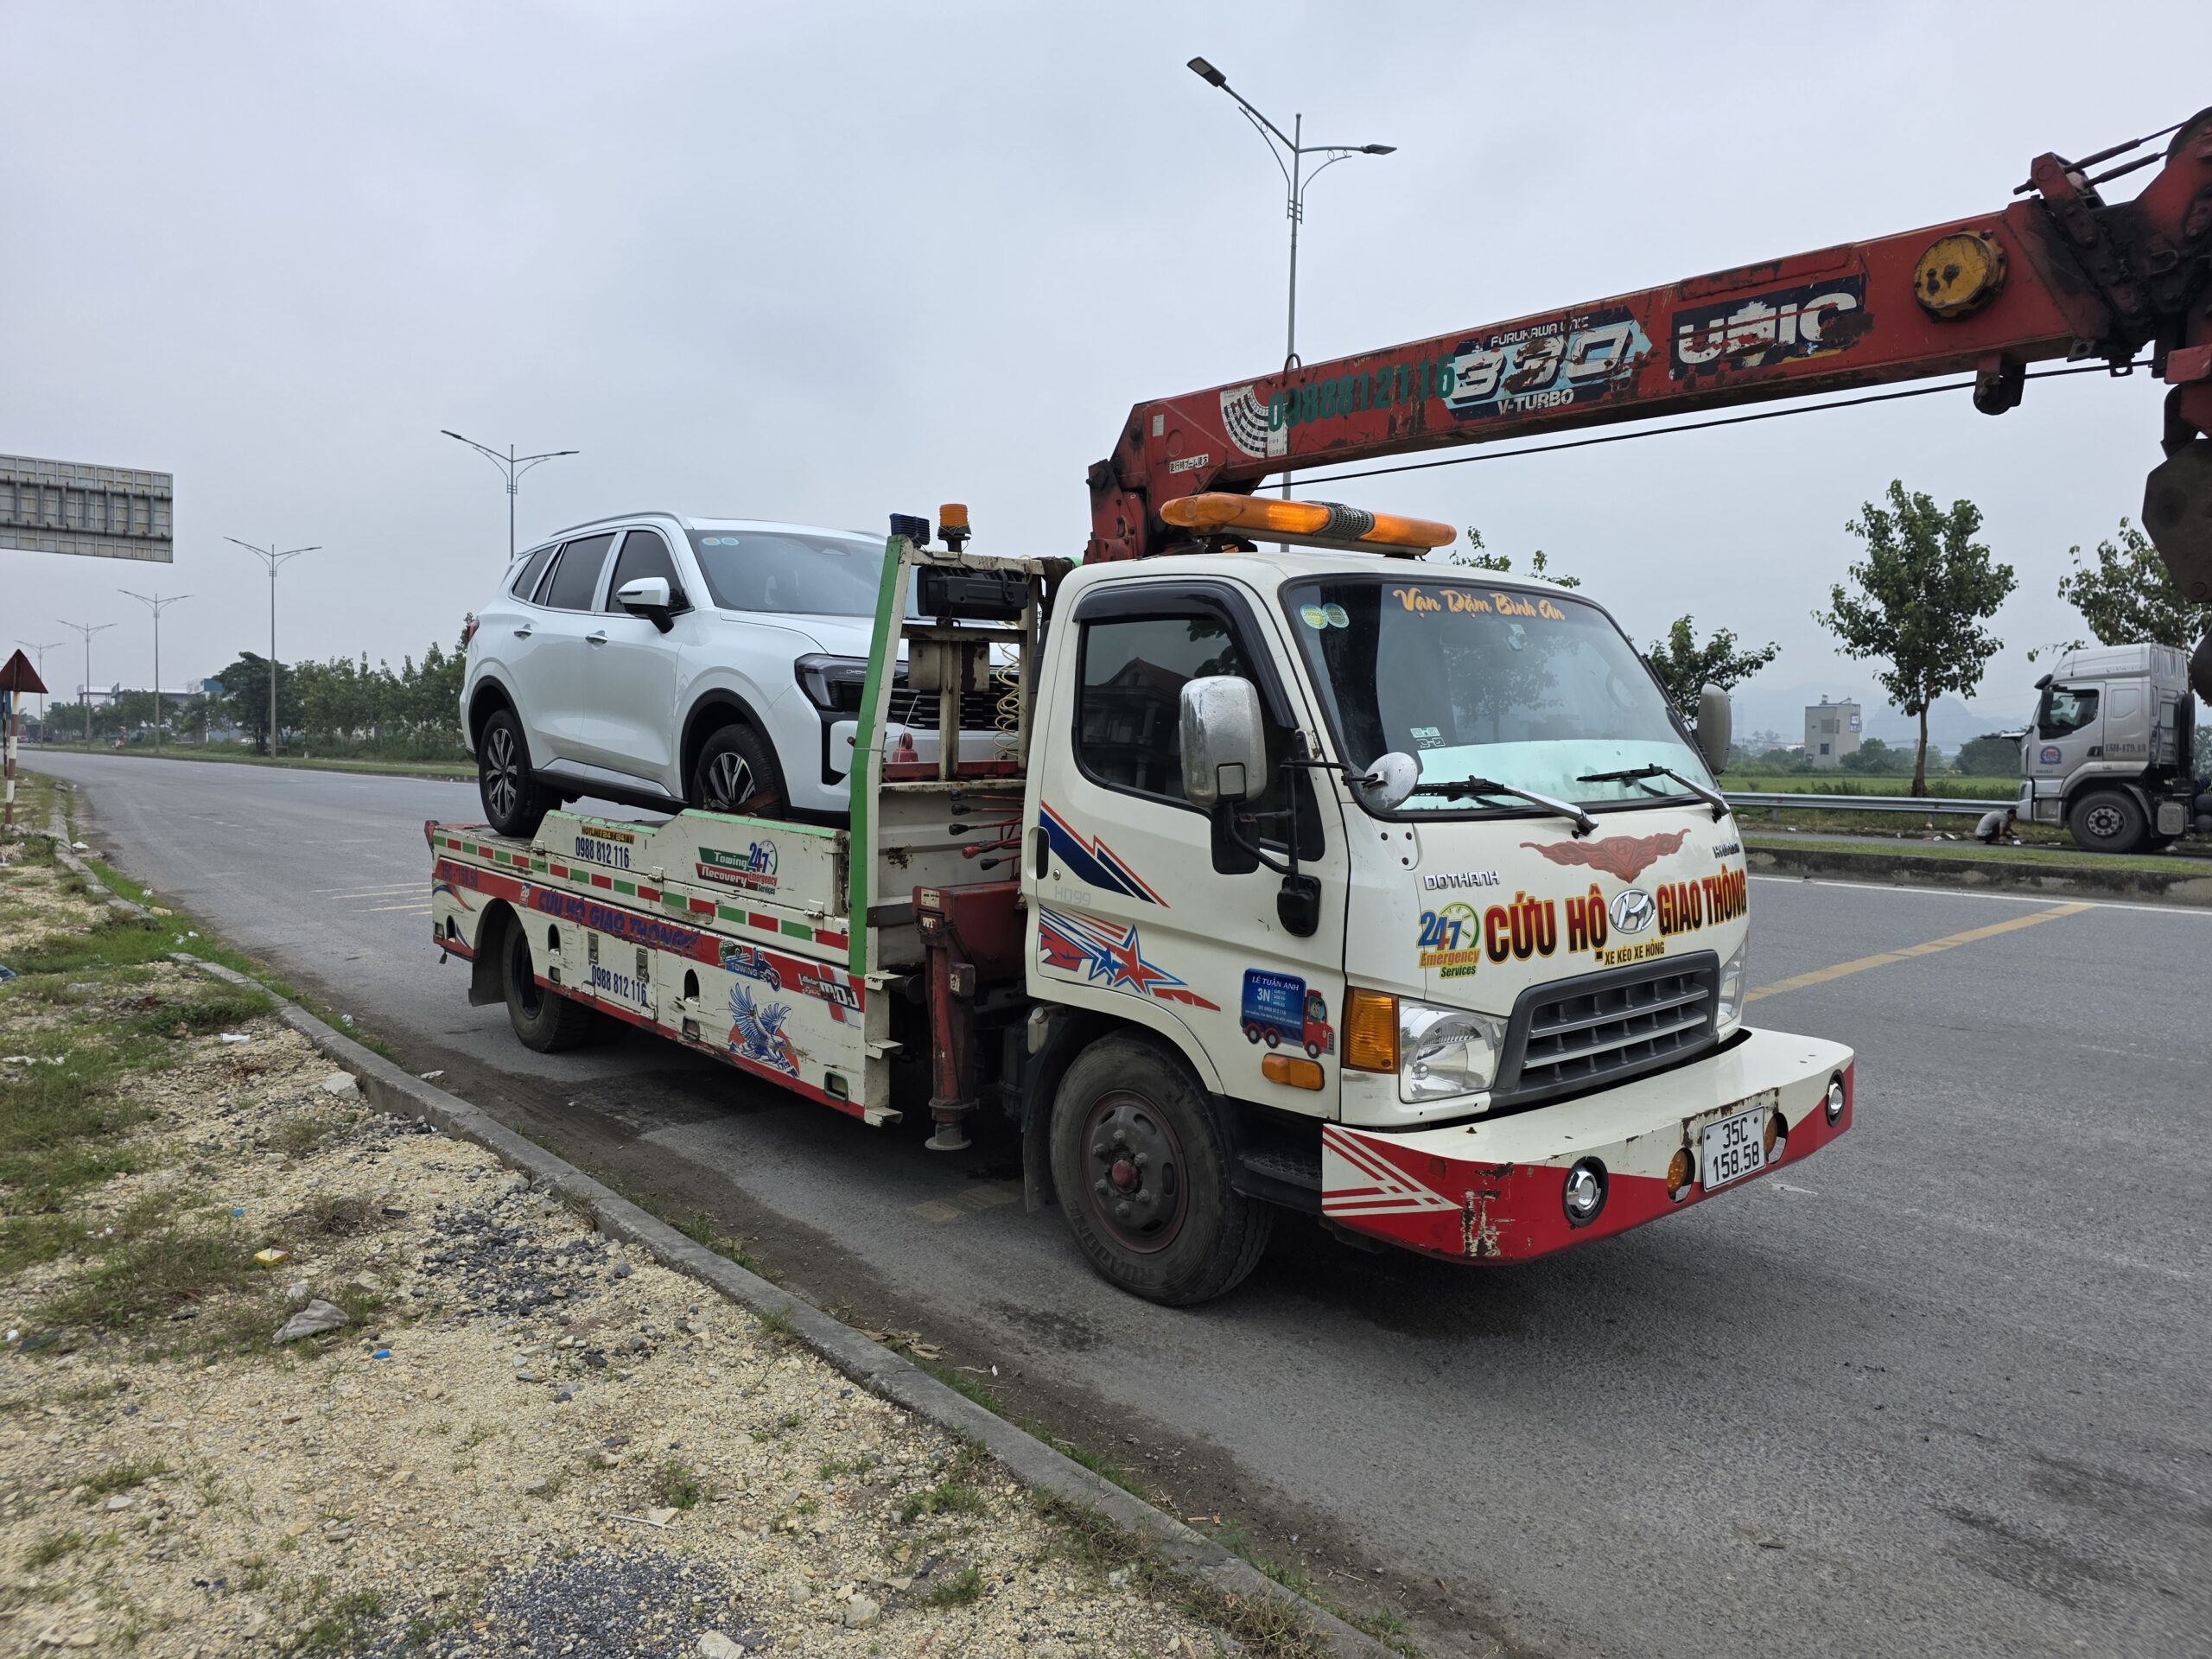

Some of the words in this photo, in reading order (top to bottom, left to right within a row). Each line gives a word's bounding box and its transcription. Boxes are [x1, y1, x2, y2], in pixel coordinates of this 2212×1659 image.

[1491, 322, 1557, 347] FURUKAWA
[1268, 353, 1456, 432] 0988812116
[1497, 388, 1575, 416] V-TURBO
[1392, 588, 1441, 619] Vạn
[1489, 593, 1536, 617] Bình
[575, 836, 594, 860] 0988
[596, 841, 612, 864] 812
[614, 845, 630, 868] 116
[713, 851, 747, 870] Towing
[702, 866, 747, 887] Recovery
[1423, 870, 1500, 891] DOTHANH
[1484, 890, 1557, 965] CỨU
[1565, 882, 1608, 962] HỘ
[1656, 879, 1703, 937] GIAO
[1700, 863, 1748, 926] THÔNG
[1420, 950, 1480, 967] Emergency
[1605, 951, 1615, 965] XE
[1618, 945, 1632, 963] KÉO
[1634, 945, 1643, 960] XE
[730, 962, 759, 977] TOWING
[1440, 964, 1477, 978] Services
[592, 964, 612, 992] 0988
[613, 973, 629, 998] 812
[632, 980, 647, 1003] 116
[1257, 988, 1270, 1002] 3N
[1282, 982, 1300, 991] ANH
[1722, 1116, 1748, 1149] 35C
[1713, 1141, 1759, 1182] 158.58
